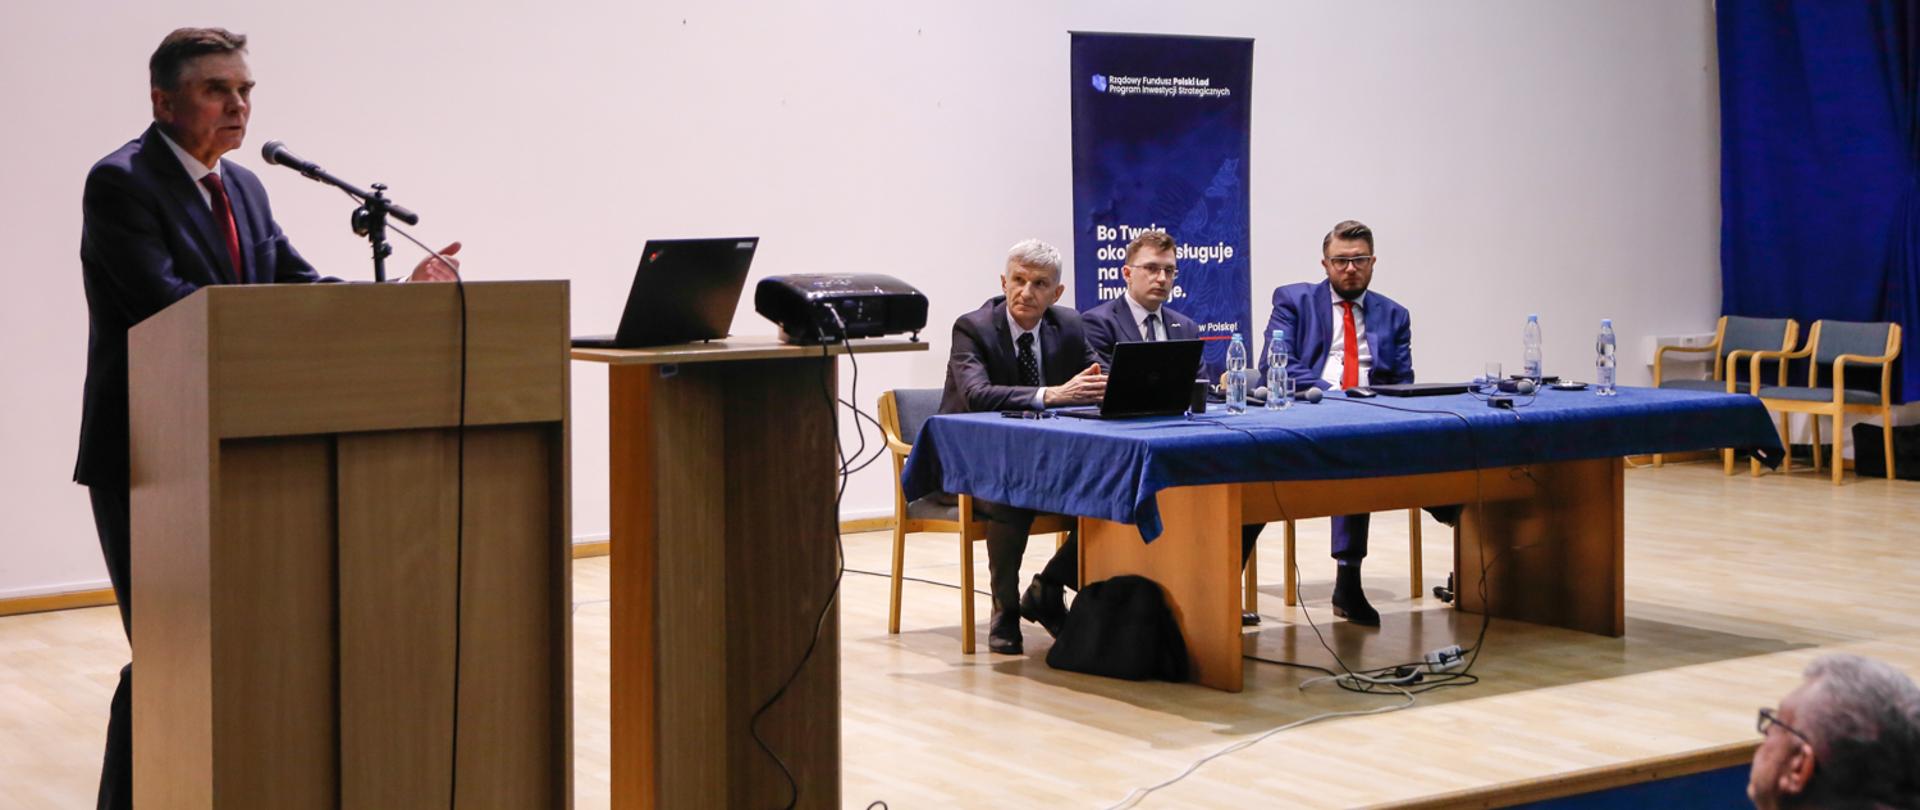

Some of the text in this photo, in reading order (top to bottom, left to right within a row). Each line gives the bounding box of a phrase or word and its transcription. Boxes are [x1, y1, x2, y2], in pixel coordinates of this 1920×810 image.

[1109, 75, 1141, 86] Rządowy
[1143, 76, 1172, 85] Fundusz
[1173, 76, 1195, 85] Polski
[1109, 85, 1231, 97] Program Inwestycji Strategicznych
[1097, 225, 1117, 241] Bo
[1175, 242, 1234, 264] sługuje
[1098, 267, 1119, 280] na
[1198, 321, 1238, 333] w Polskę!
